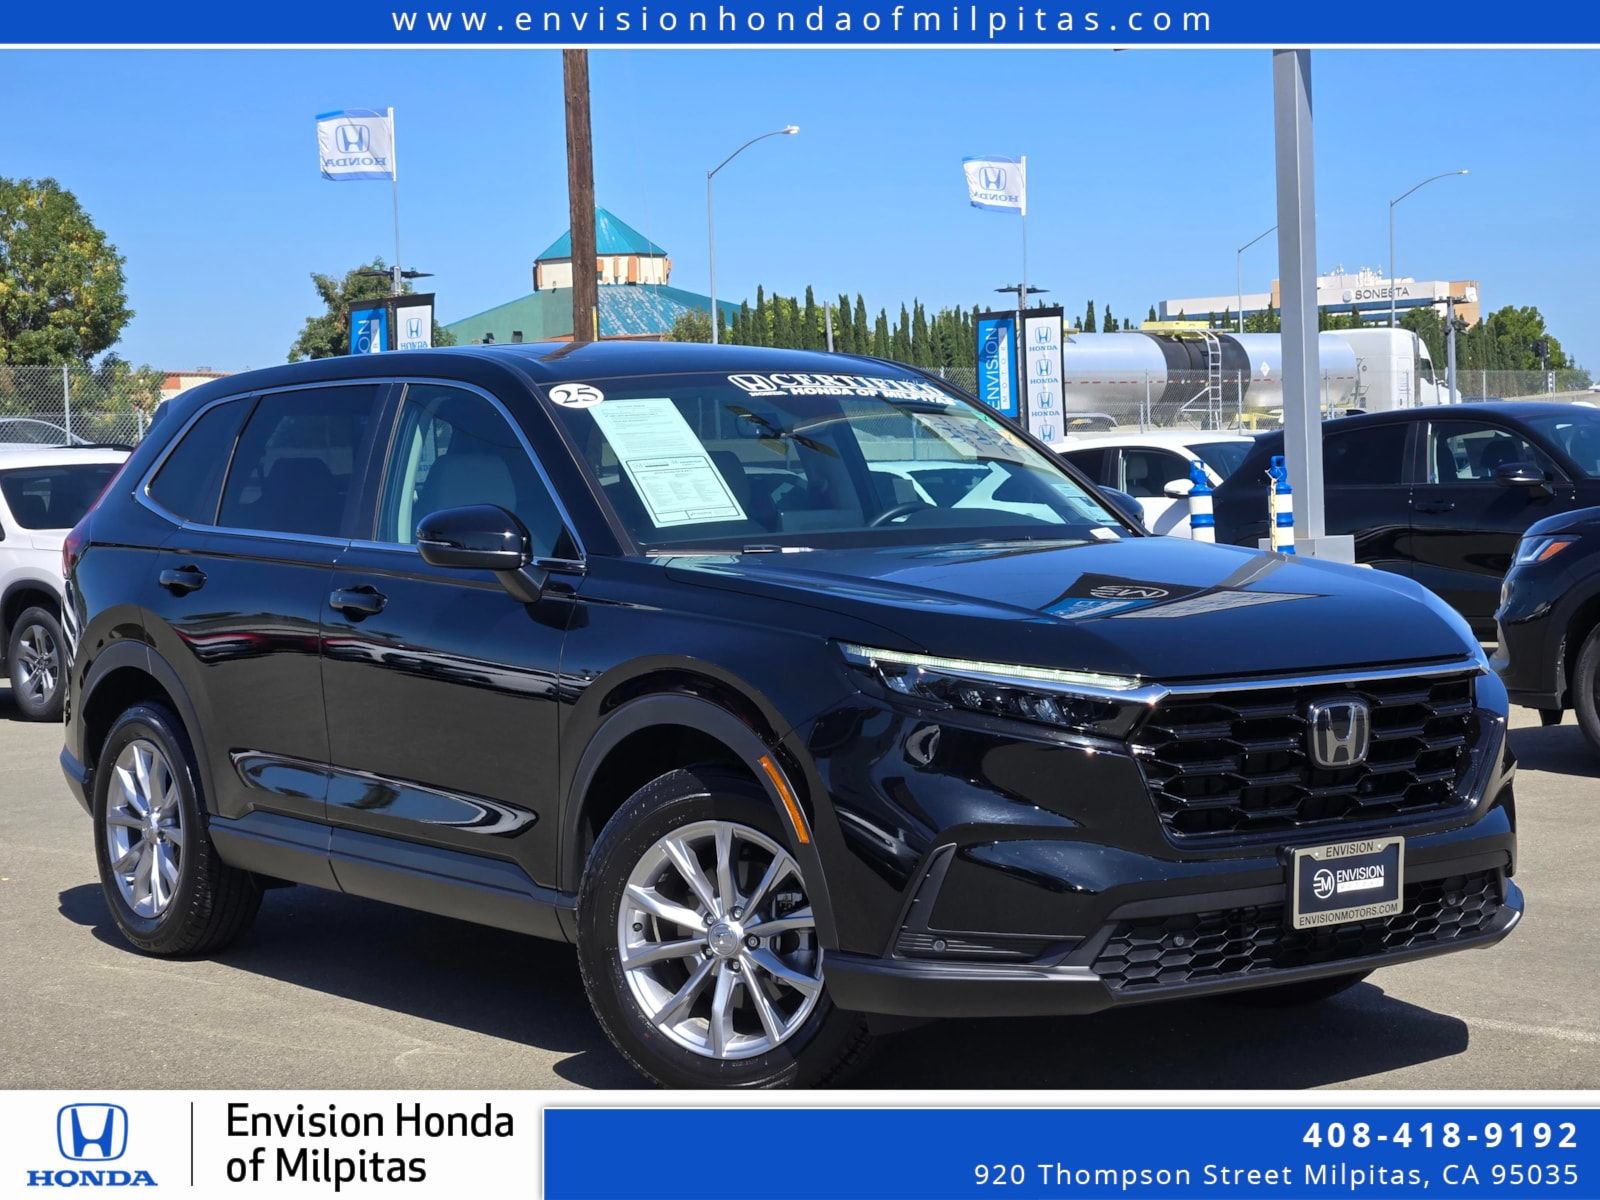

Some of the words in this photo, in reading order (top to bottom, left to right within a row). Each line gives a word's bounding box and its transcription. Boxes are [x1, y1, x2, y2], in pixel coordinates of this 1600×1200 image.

[986, 327, 1000, 411] ENVISION
[769, 373, 946, 397] CERTIFIED
[1030, 377, 1058, 385] HONDA
[554, 387, 598, 404] 25
[791, 386, 850, 396] HONDA
[855, 388, 878, 397] OF
[1325, 841, 1374, 858] ENVISION
[1336, 864, 1385, 883] ENVISION
[1299, 902, 1398, 927] ENVISIONMOTORS.COM
